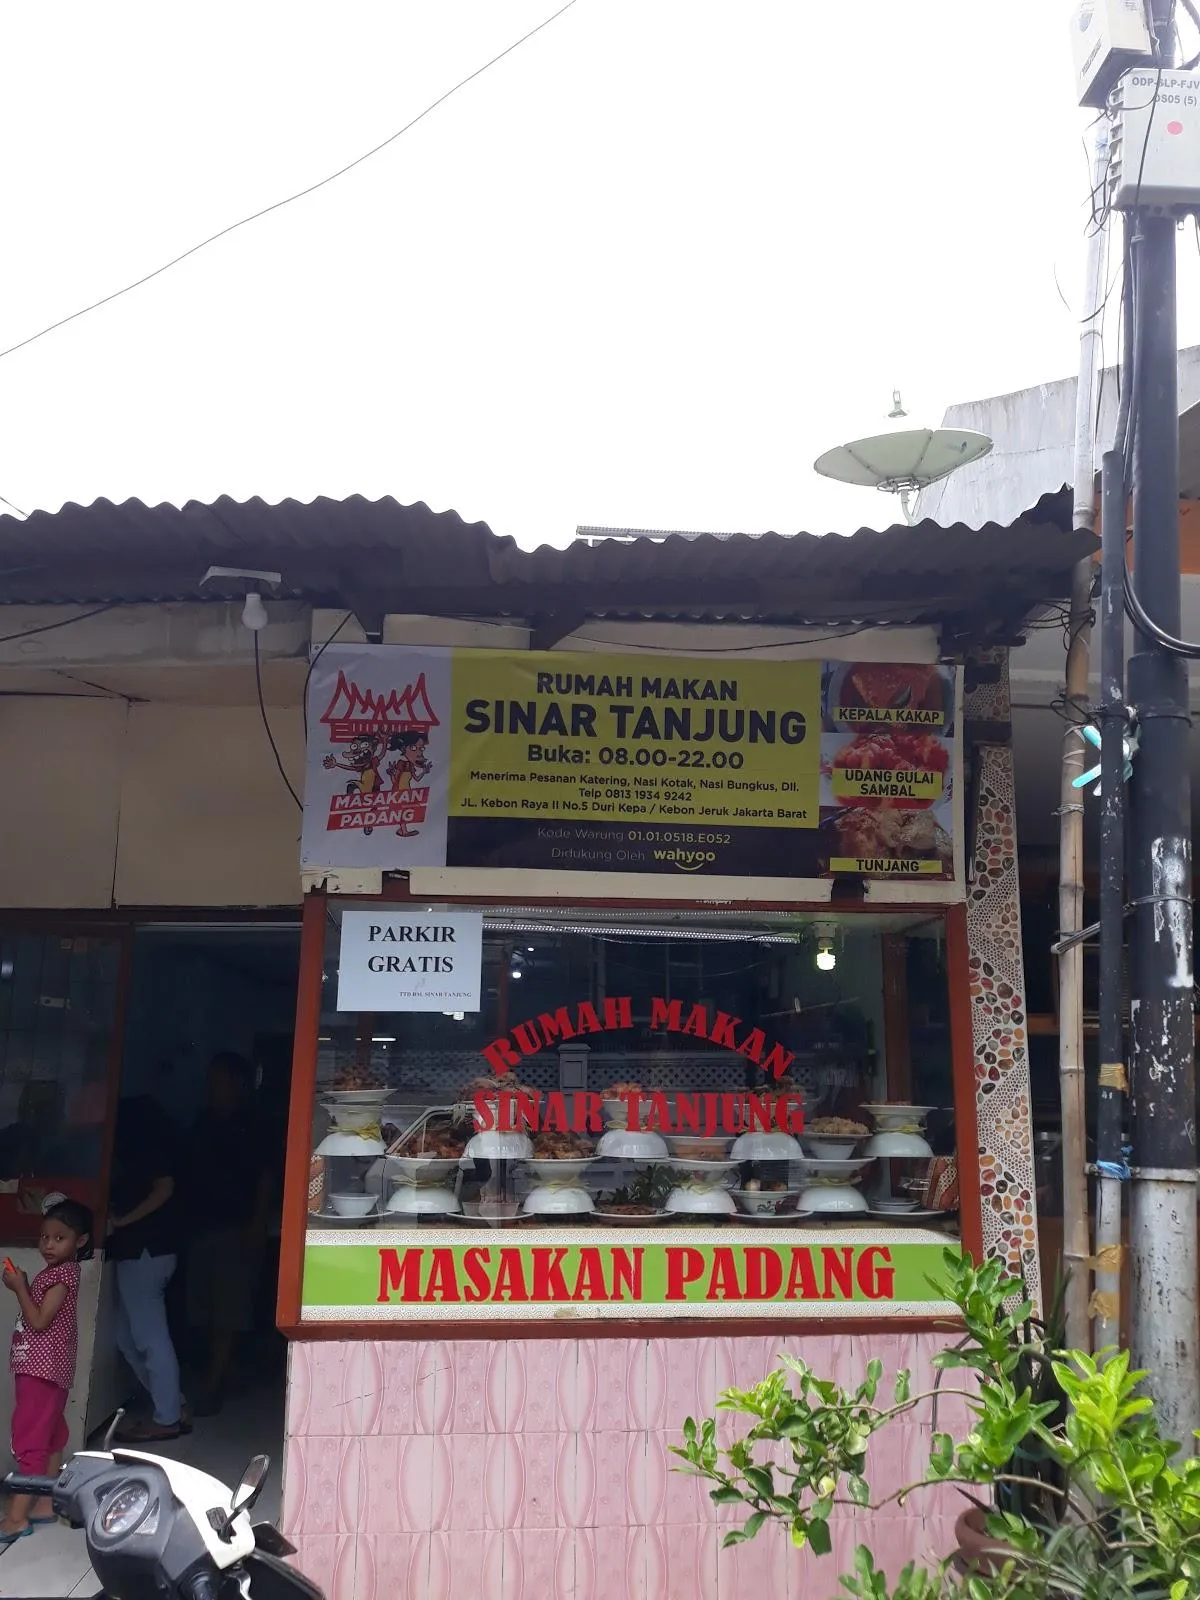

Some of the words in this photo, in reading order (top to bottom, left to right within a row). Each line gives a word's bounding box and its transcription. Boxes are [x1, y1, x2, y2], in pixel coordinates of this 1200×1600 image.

[1183, 95, 1197, 107] (5)
[537, 672, 633, 697] RUMAH
[641, 676, 737, 701] MAKAN
[464, 700, 597, 738] SINAR
[610, 705, 806, 744] TANJUNG
[839, 708, 891, 721] KEPALA
[896, 710, 940, 723] KAKAP
[528, 744, 590, 764] Buka:
[599, 747, 744, 769] 08.00-22.00
[470, 771, 526, 782] Menerima
[530, 773, 576, 783] Pesanan
[580, 775, 630, 787] Katering,
[633, 777, 657, 787] Nasi
[661, 778, 696, 789] Kotak,
[700, 779, 724, 789] Nasi
[728, 780, 778, 792] Bungkus,
[845, 770, 892, 782] UDANG
[896, 772, 934, 784] GULAI
[335, 789, 424, 809] MASAKAN
[579, 788, 601, 799] Telp
[605, 789, 630, 799] 0813
[635, 790, 660, 800] 1934
[664, 791, 692, 801] 9242
[860, 784, 915, 797] SAMBAL
[461, 798, 477, 808] JL.
[481, 799, 517, 809] Kebon
[521, 800, 549, 811] Raya
[563, 801, 588, 811] No.5
[592, 802, 614, 812] Duri
[619, 803, 646, 814] Kepa
[650, 804, 656, 815] /
[659, 805, 694, 815] Kebon
[698, 806, 729, 816] Jeruk
[732, 807, 774, 818] Jakarta
[777, 808, 807, 819] Barat
[340, 809, 415, 827] PADANG
[537, 827, 570, 839] Kode
[575, 829, 624, 842] Warung
[628, 830, 731, 844] 01.01.0518.E052
[551, 847, 612, 860] Didukung
[616, 849, 645, 861] Oleh
[653, 848, 716, 863] wahyoo
[856, 859, 919, 872] TUNJANG
[367, 925, 456, 943] PARKIR
[368, 956, 453, 973] GRATIS
[481, 996, 634, 1077] RUMAH
[651, 997, 796, 1080] MAKAN
[472, 1091, 604, 1133] SINAR
[620, 1091, 806, 1138] TANJUNG
[376, 1247, 645, 1303] MASAKAN
[665, 1246, 896, 1301] PADANG
